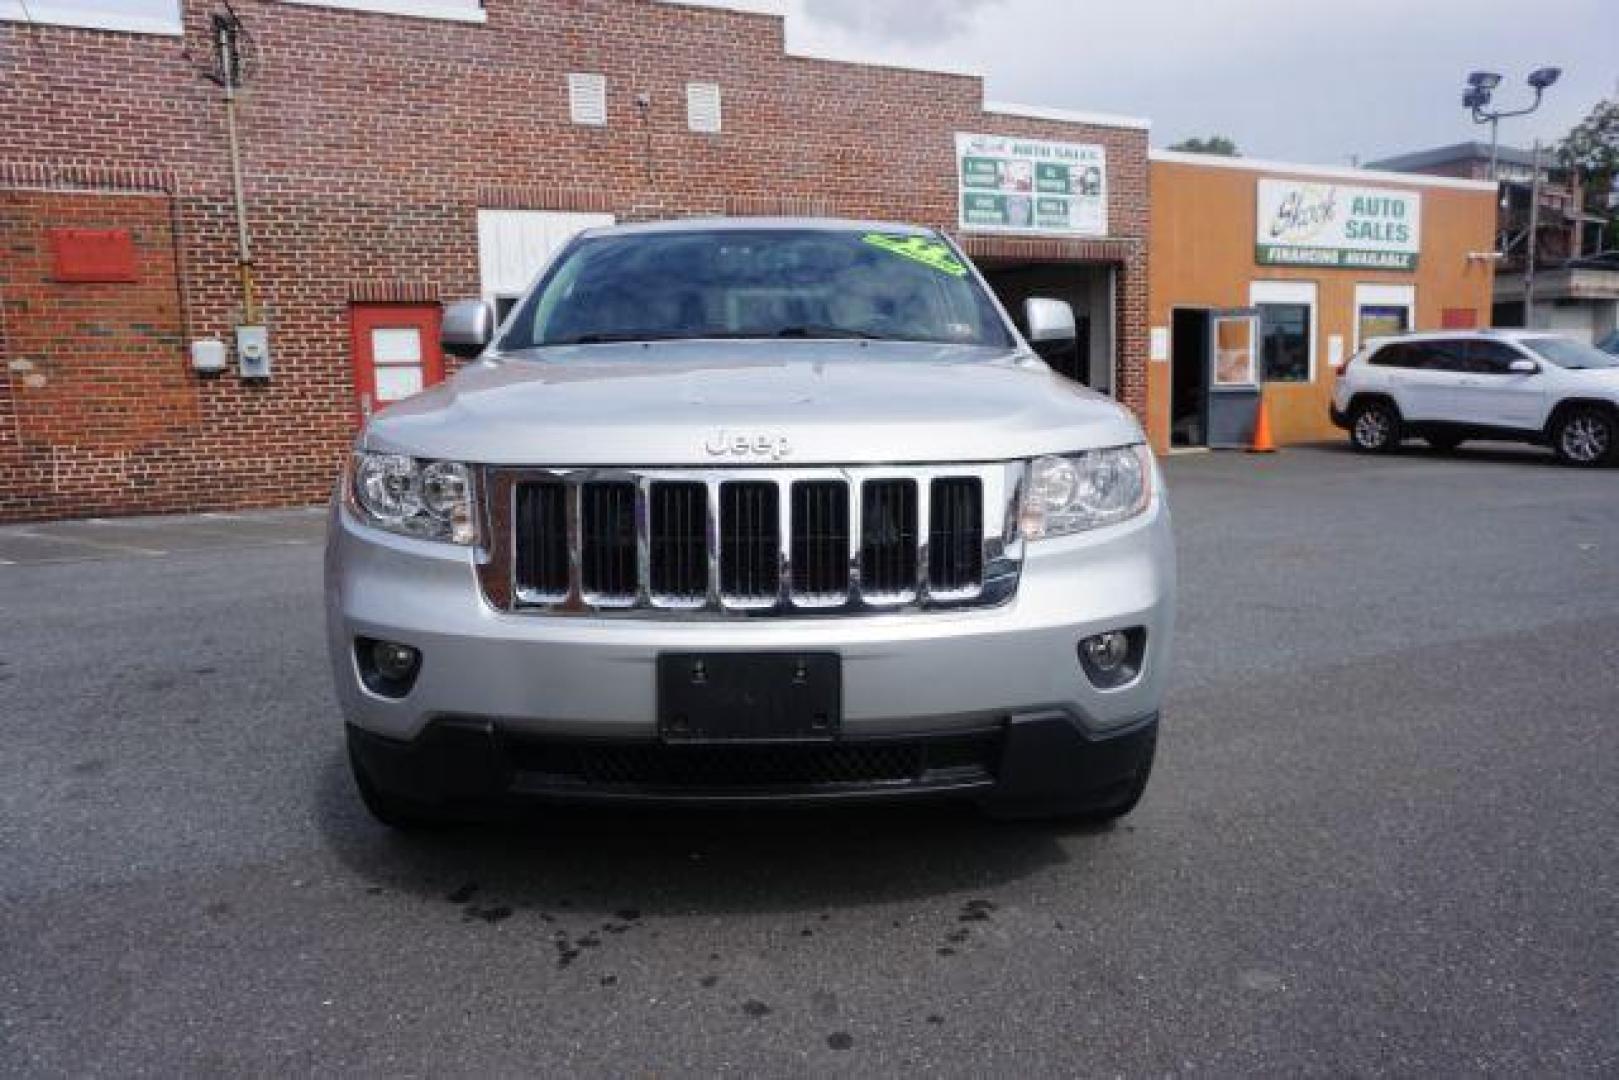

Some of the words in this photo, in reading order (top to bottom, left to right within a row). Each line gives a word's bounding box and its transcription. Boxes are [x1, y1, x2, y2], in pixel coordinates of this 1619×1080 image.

[1352, 197, 1406, 218] AUTO
[1345, 220, 1411, 243] SALES
[705, 427, 793, 461] Jeep
